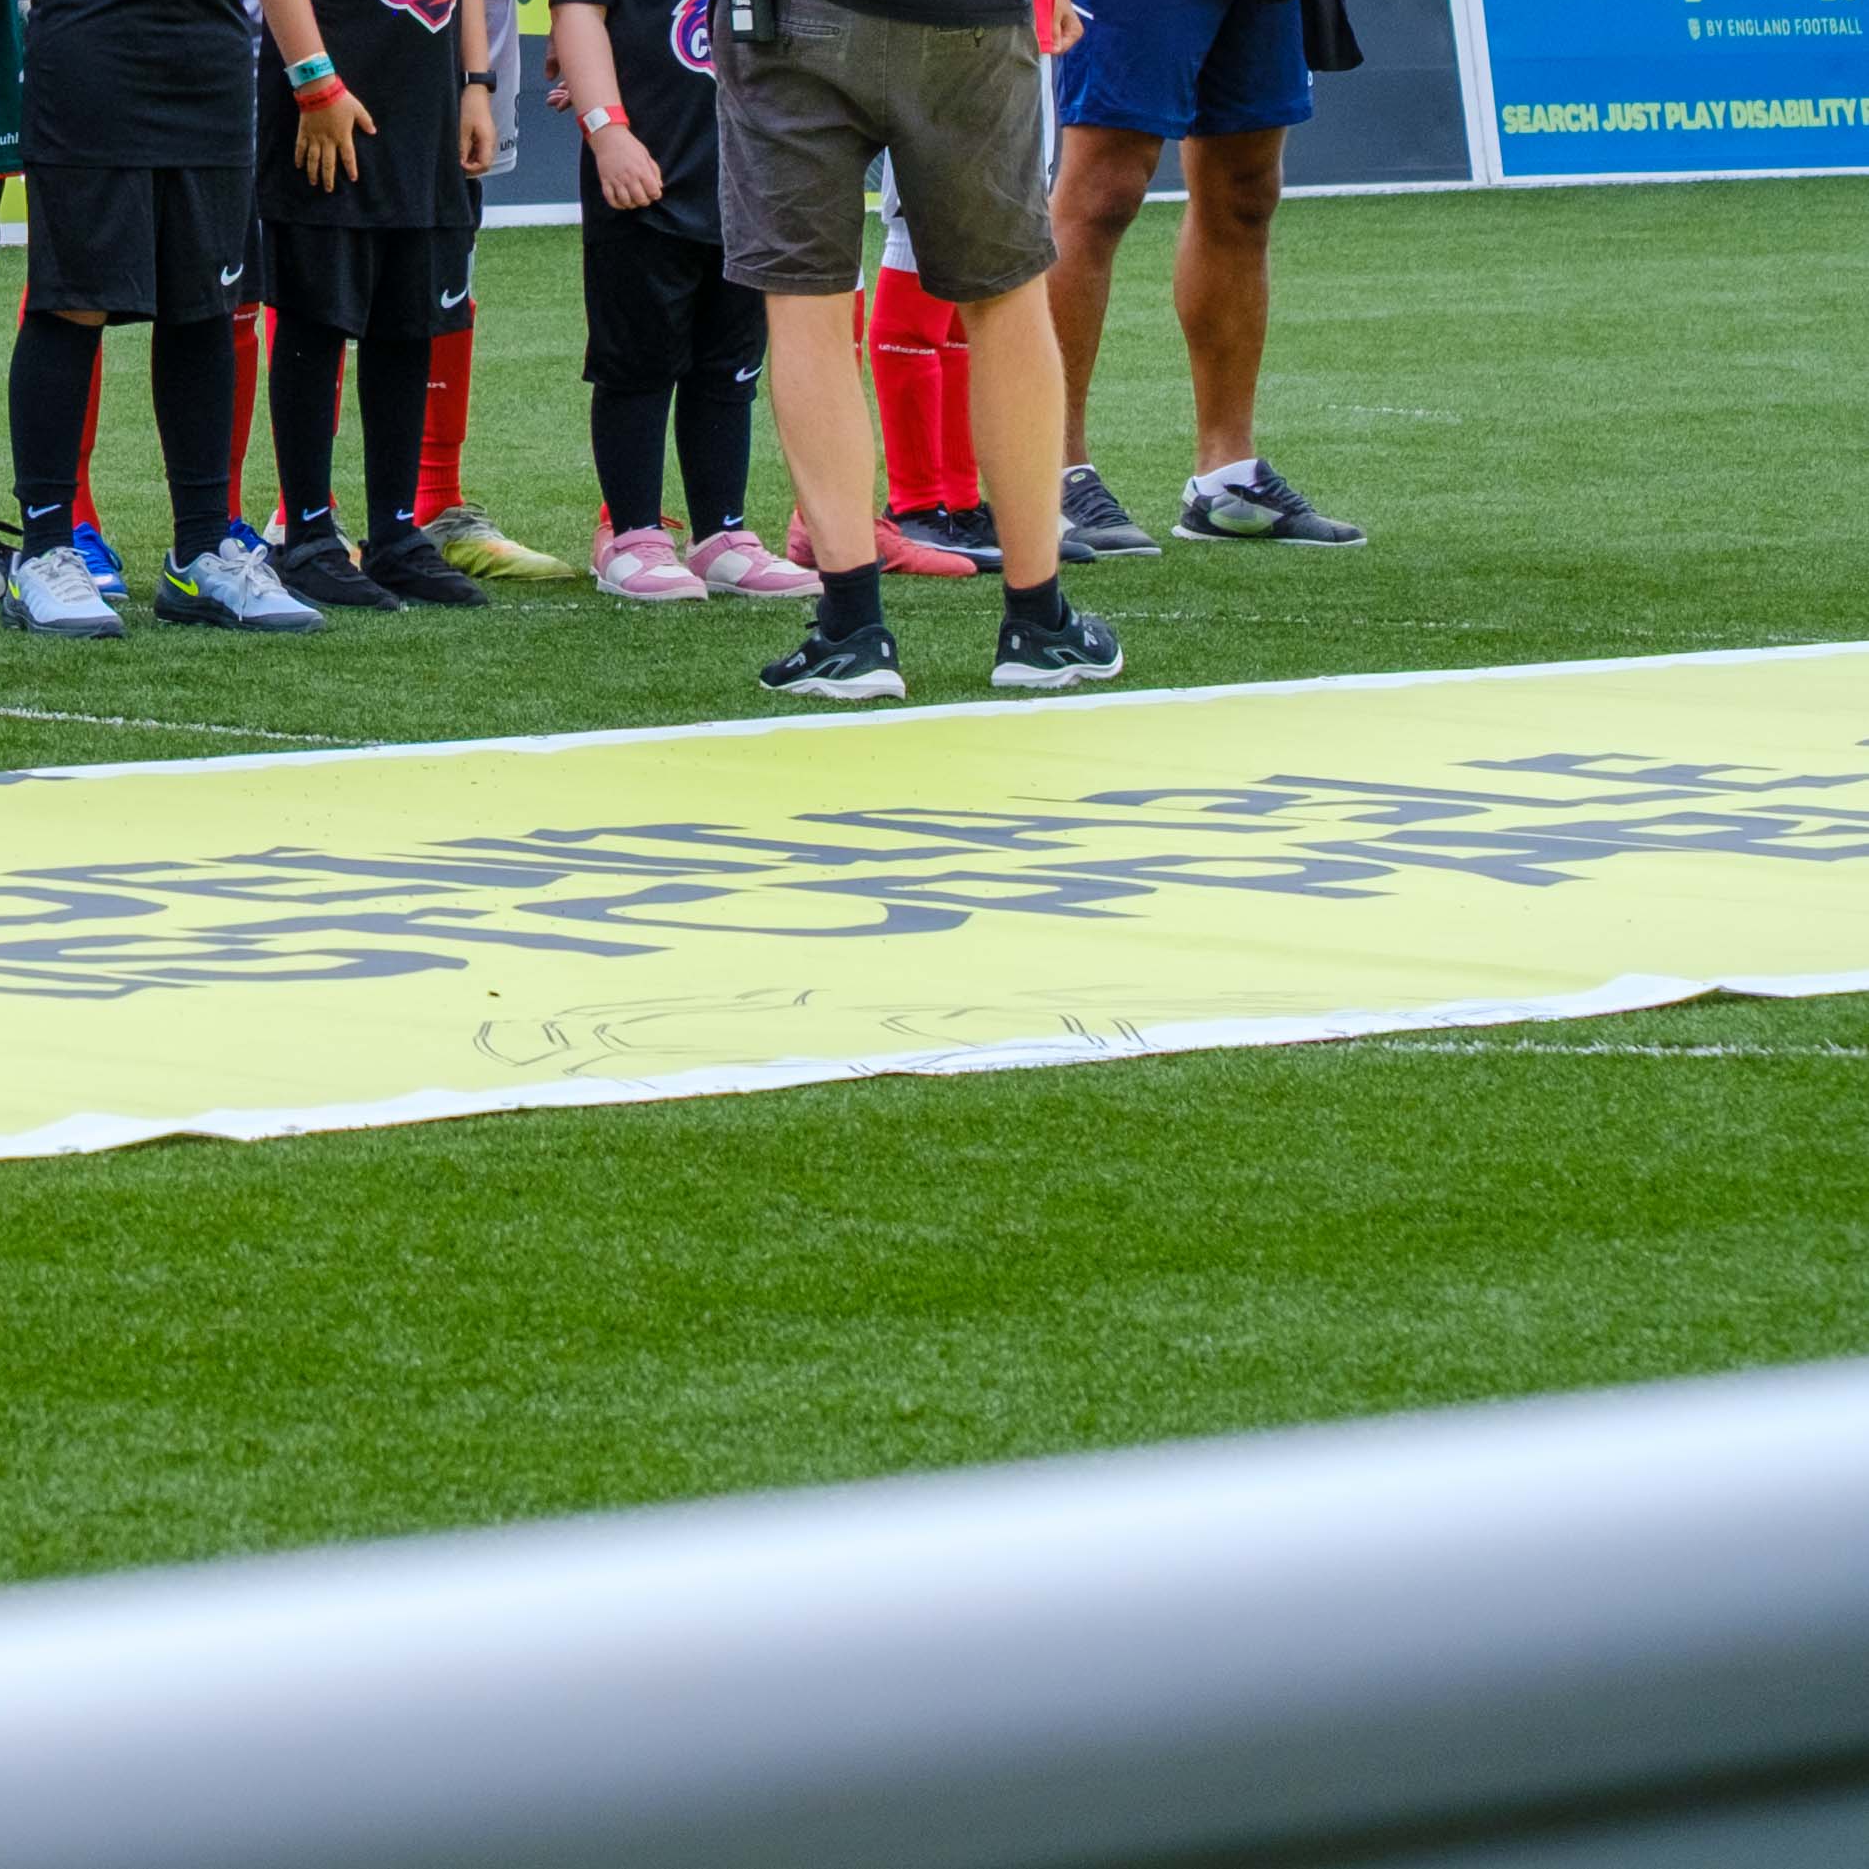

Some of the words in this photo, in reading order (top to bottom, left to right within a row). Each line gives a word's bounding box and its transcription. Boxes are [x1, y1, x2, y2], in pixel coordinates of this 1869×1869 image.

[1706, 18, 1724, 36] BY
[1728, 18, 1791, 35] ENGLAND
[1794, 16, 1863, 34] FOOTBALL
[1502, 104, 1599, 134] SEARCH
[1602, 102, 1661, 131] JUST
[1665, 101, 1727, 130] PLAY
[1729, 98, 1857, 129] DISABILITY
